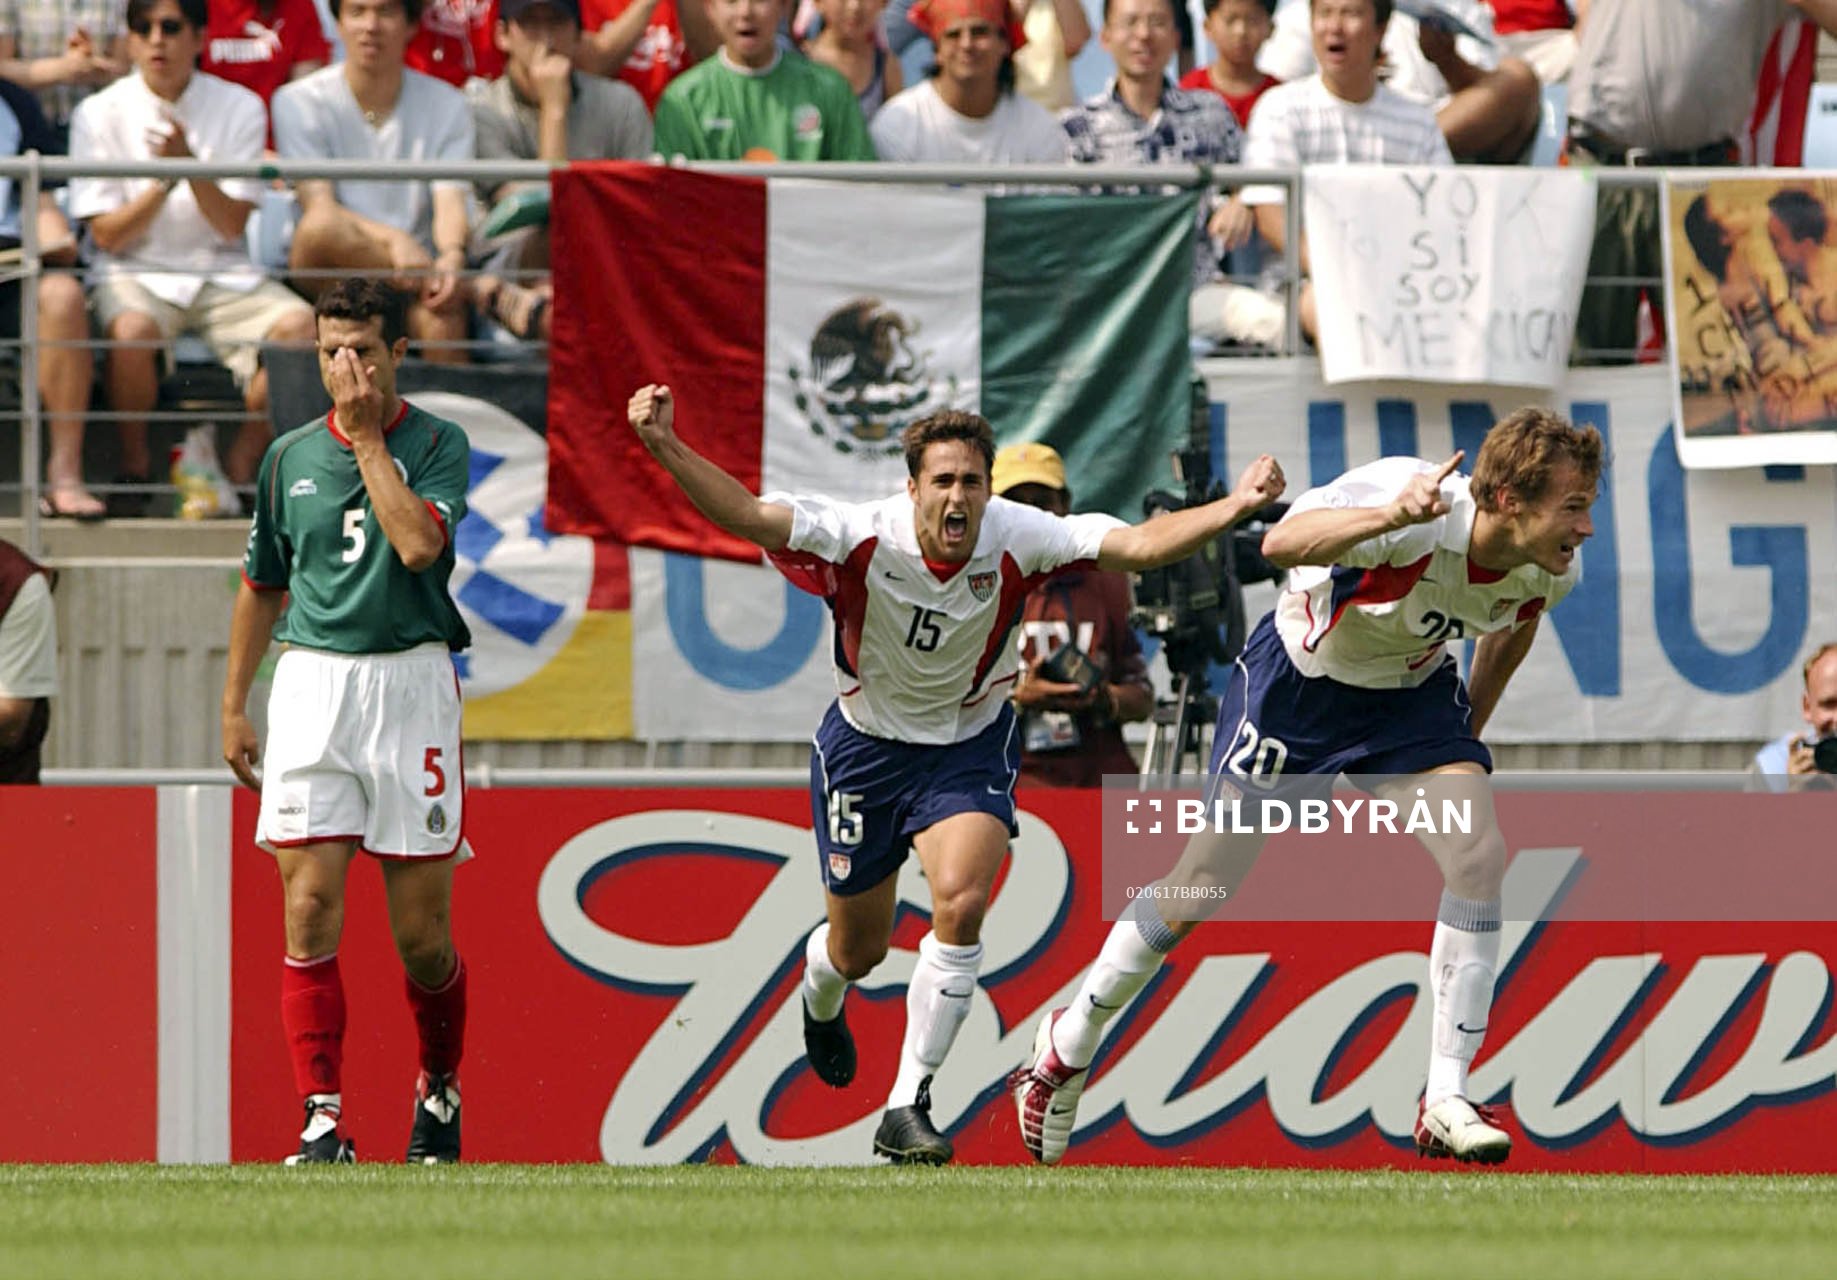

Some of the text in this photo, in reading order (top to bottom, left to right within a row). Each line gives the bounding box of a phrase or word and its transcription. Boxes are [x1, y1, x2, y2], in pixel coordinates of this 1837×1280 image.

[1396, 272, 1478, 305] SOY
[341, 508, 367, 564] 5
[904, 605, 948, 652] 15
[423, 747, 446, 797] 5
[1227, 720, 1288, 790] 20
[829, 789, 865, 846] 15
